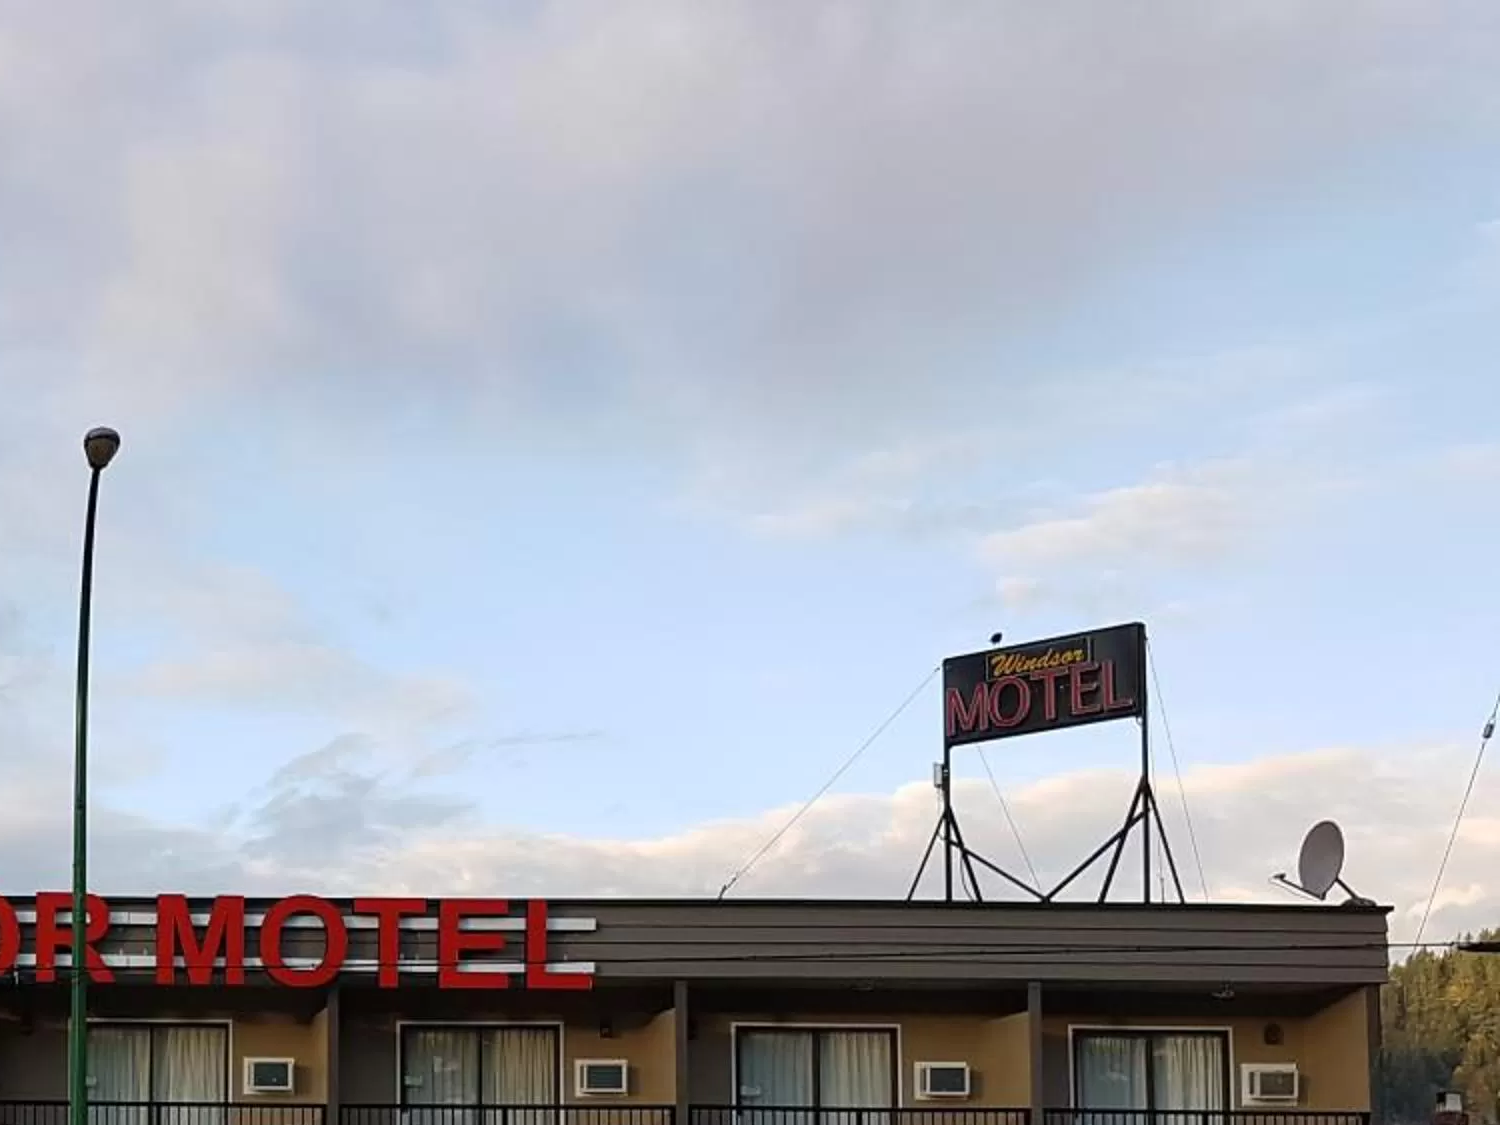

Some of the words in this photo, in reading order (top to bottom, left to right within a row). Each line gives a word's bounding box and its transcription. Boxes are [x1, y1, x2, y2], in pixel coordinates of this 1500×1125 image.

[946, 659, 1134, 737] MOTEL
[990, 647, 1085, 677] Windsor
[156, 894, 593, 990] MOTEL
